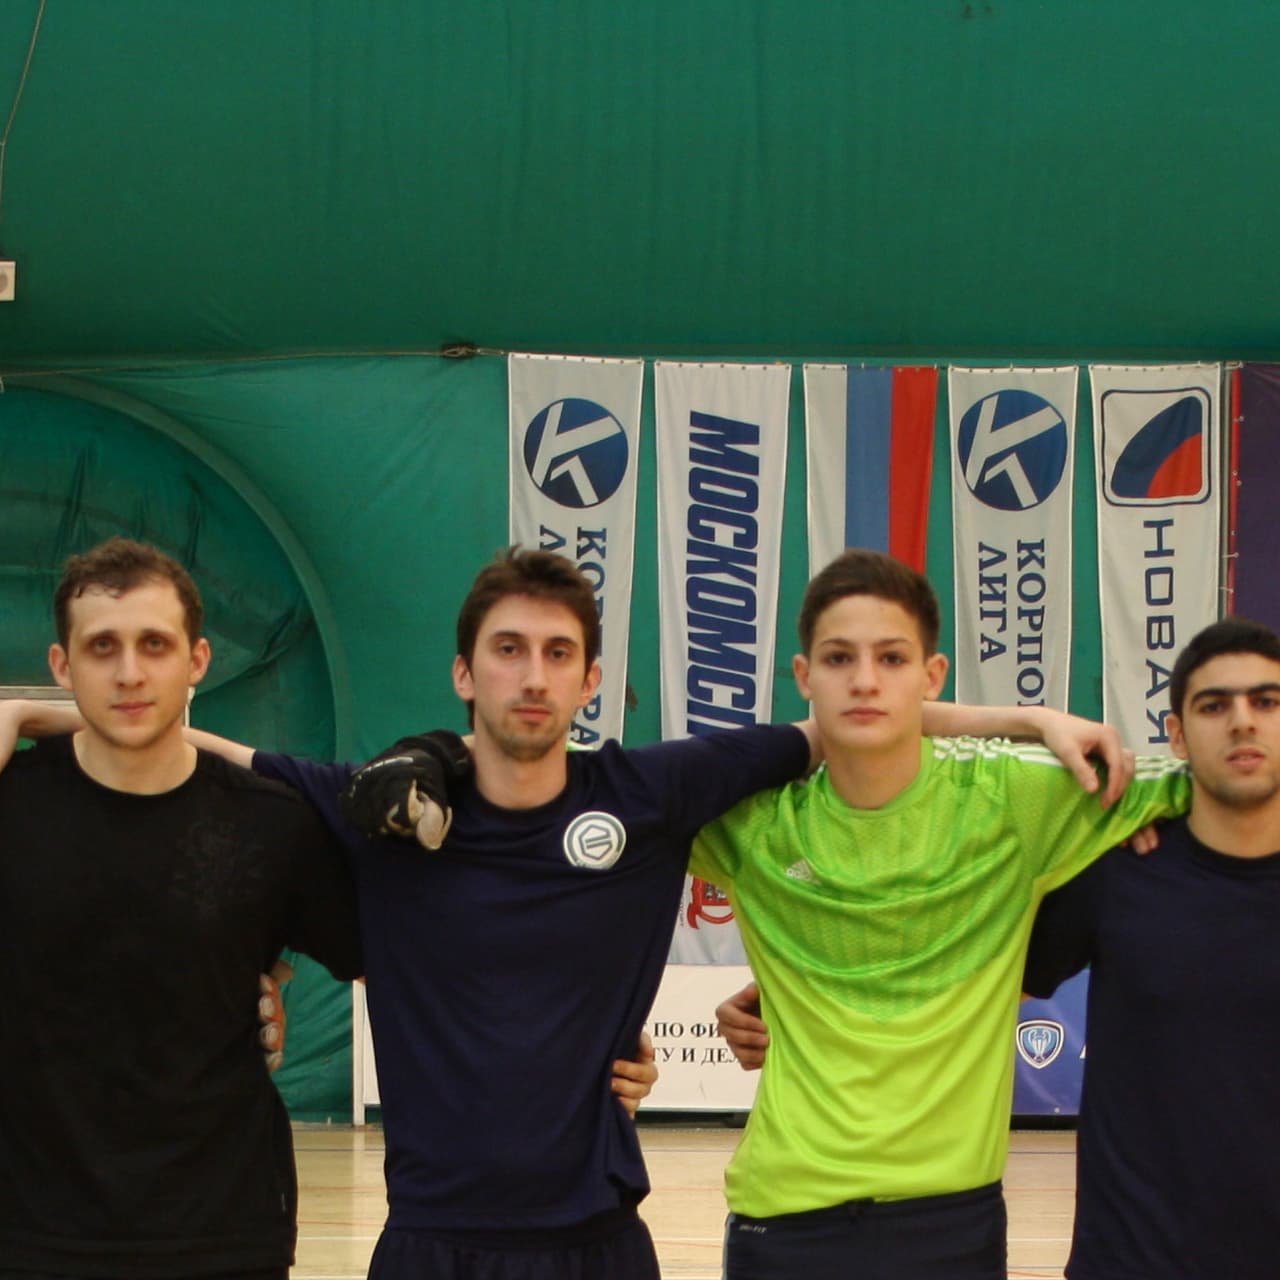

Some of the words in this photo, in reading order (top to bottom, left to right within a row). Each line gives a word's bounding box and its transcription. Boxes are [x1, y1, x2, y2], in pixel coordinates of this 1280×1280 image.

[978, 542, 1007, 663] ЛИГА
[654, 1022, 684, 1037] ПО
[682, 1048, 695, 1062] И
